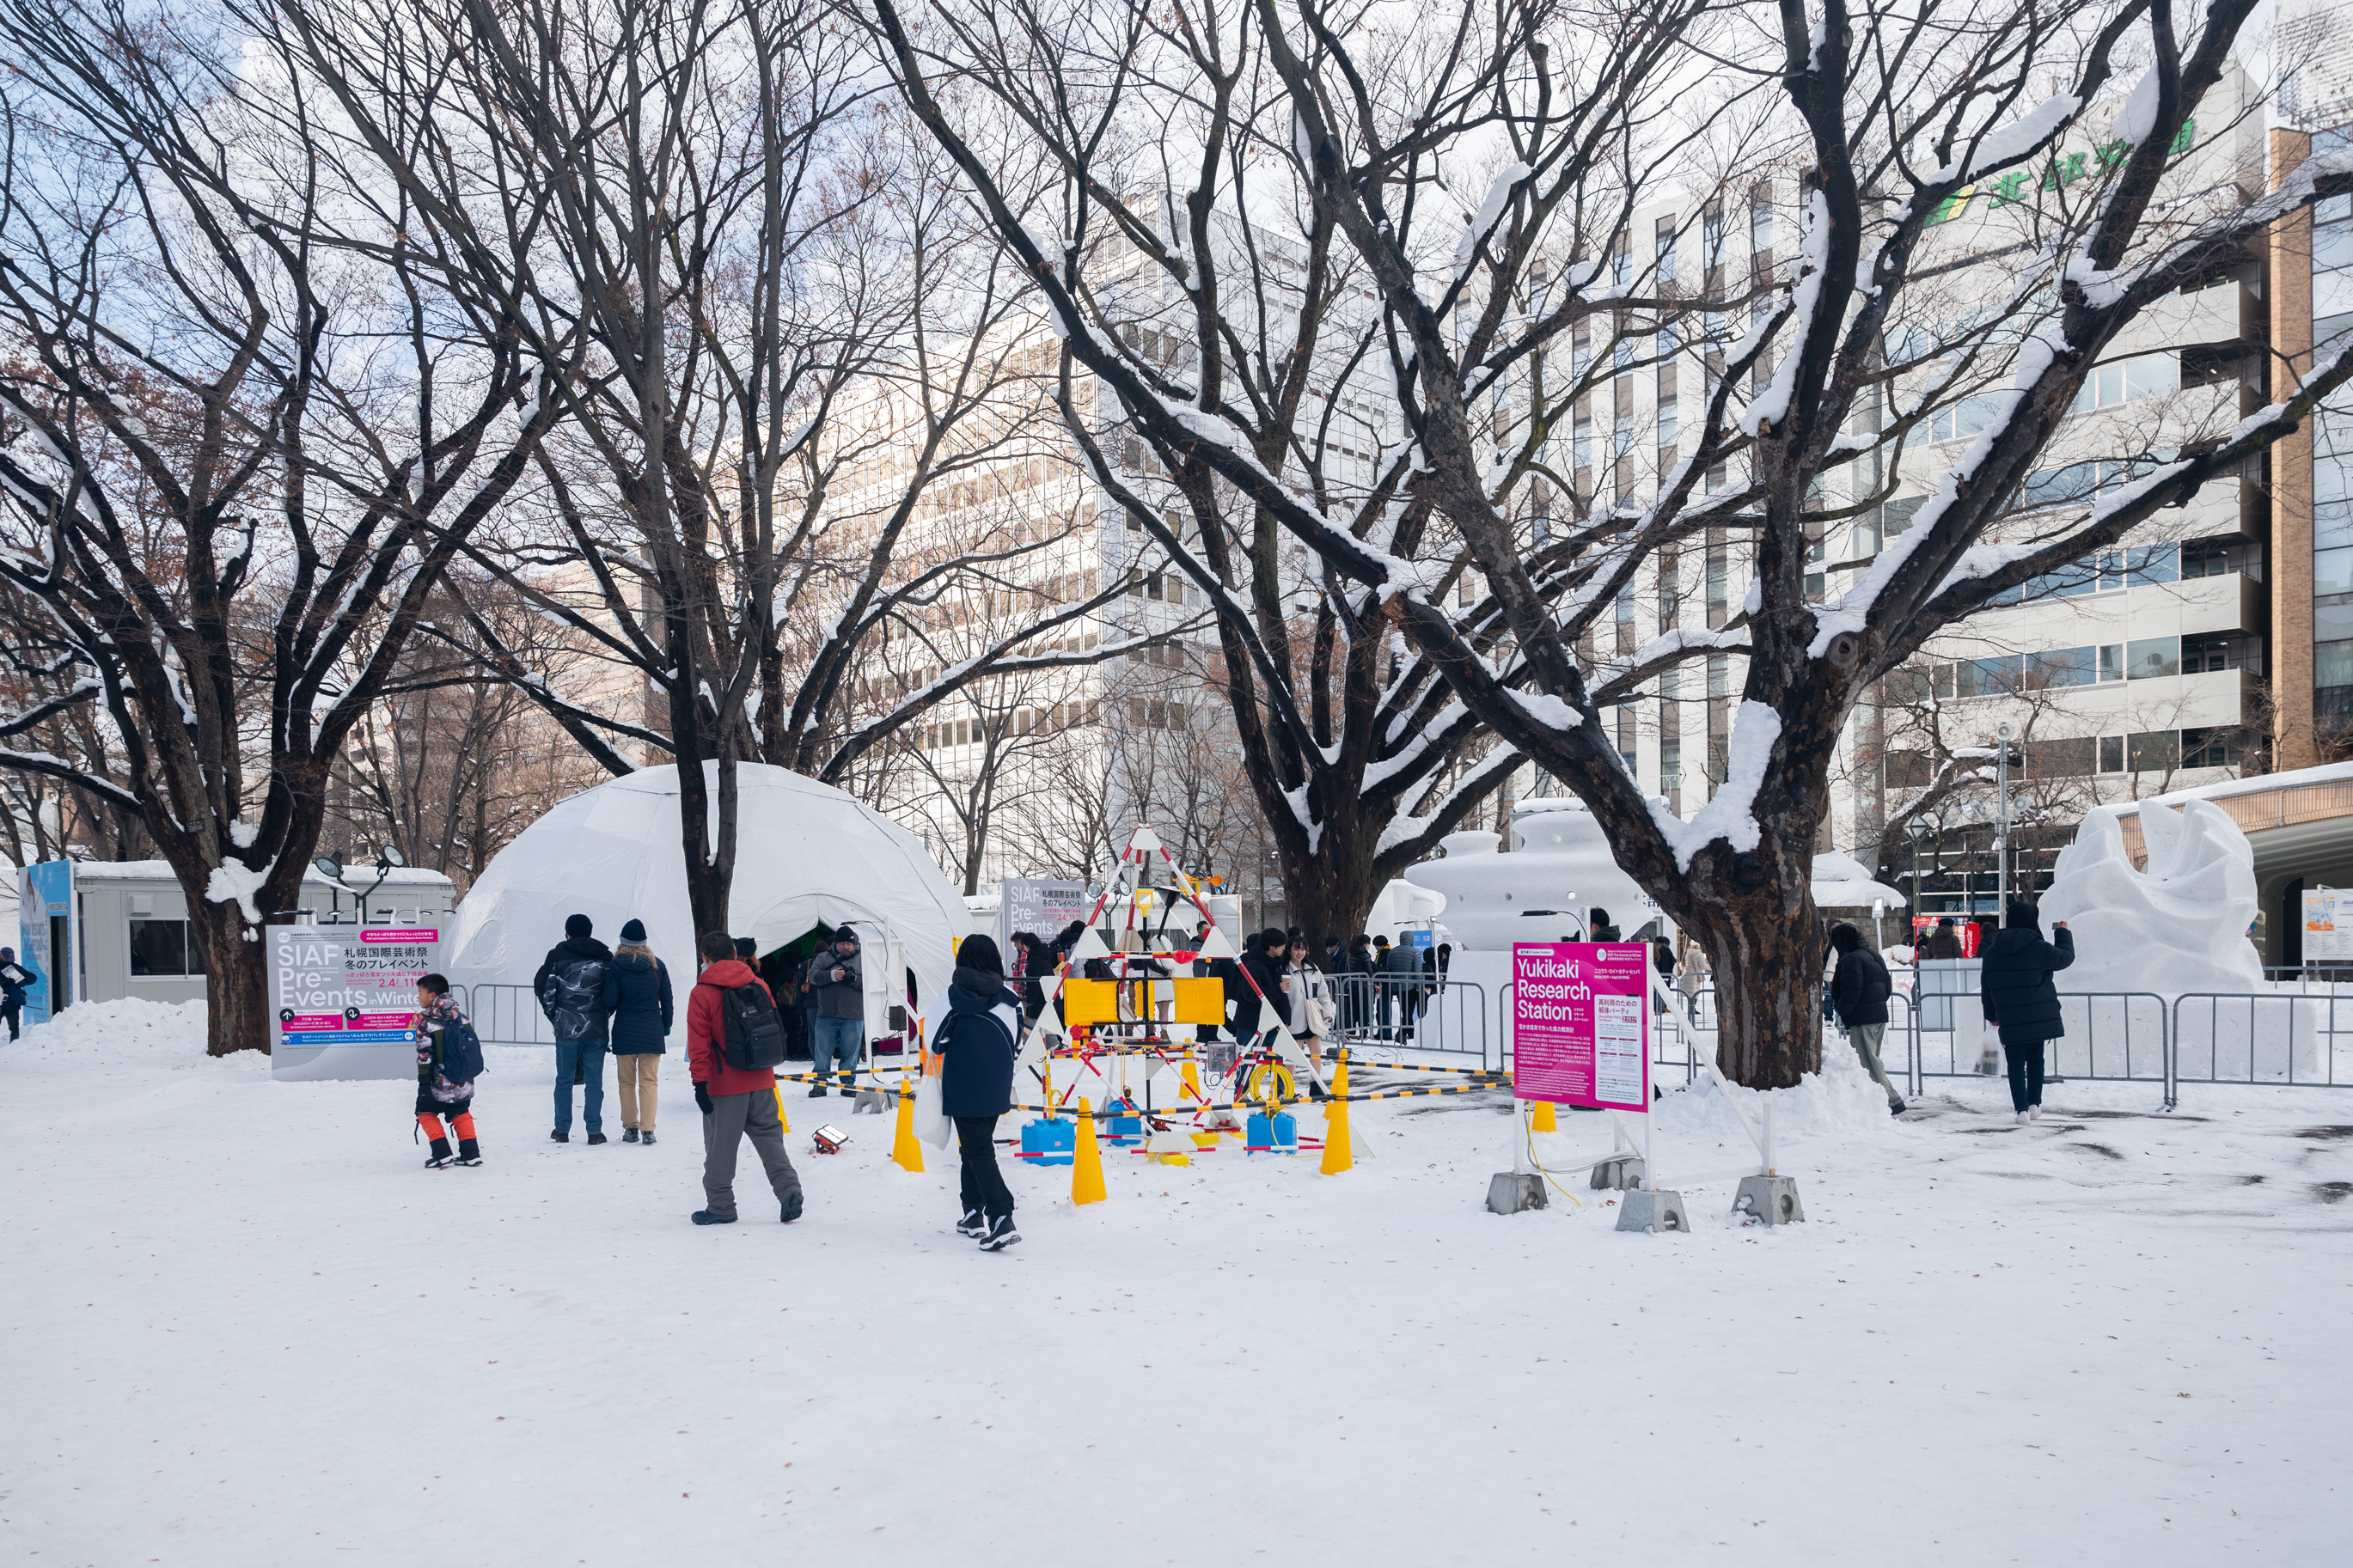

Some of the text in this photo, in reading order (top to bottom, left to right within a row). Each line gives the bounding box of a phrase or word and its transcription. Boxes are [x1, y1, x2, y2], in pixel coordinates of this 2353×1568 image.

[1011, 886, 1040, 903] SIAF
[1042, 890, 1081, 899] 札幌国際芸術祭
[1011, 904, 1036, 920] Pre-
[1011, 918, 1054, 935] Events
[278, 945, 339, 966] SIAF
[345, 947, 428, 958] 札幌国際芸術祭
[345, 959, 428, 970] 冬のプレイベント
[1517, 958, 1579, 978] Yukikaki
[279, 967, 332, 988] Pre-
[378, 979, 395, 987] 2.4
[405, 979, 414, 987] 11
[280, 986, 367, 1007] Events
[376, 991, 419, 1005] Winte
[1518, 979, 1590, 1000] Research
[1518, 999, 1572, 1021] Station
